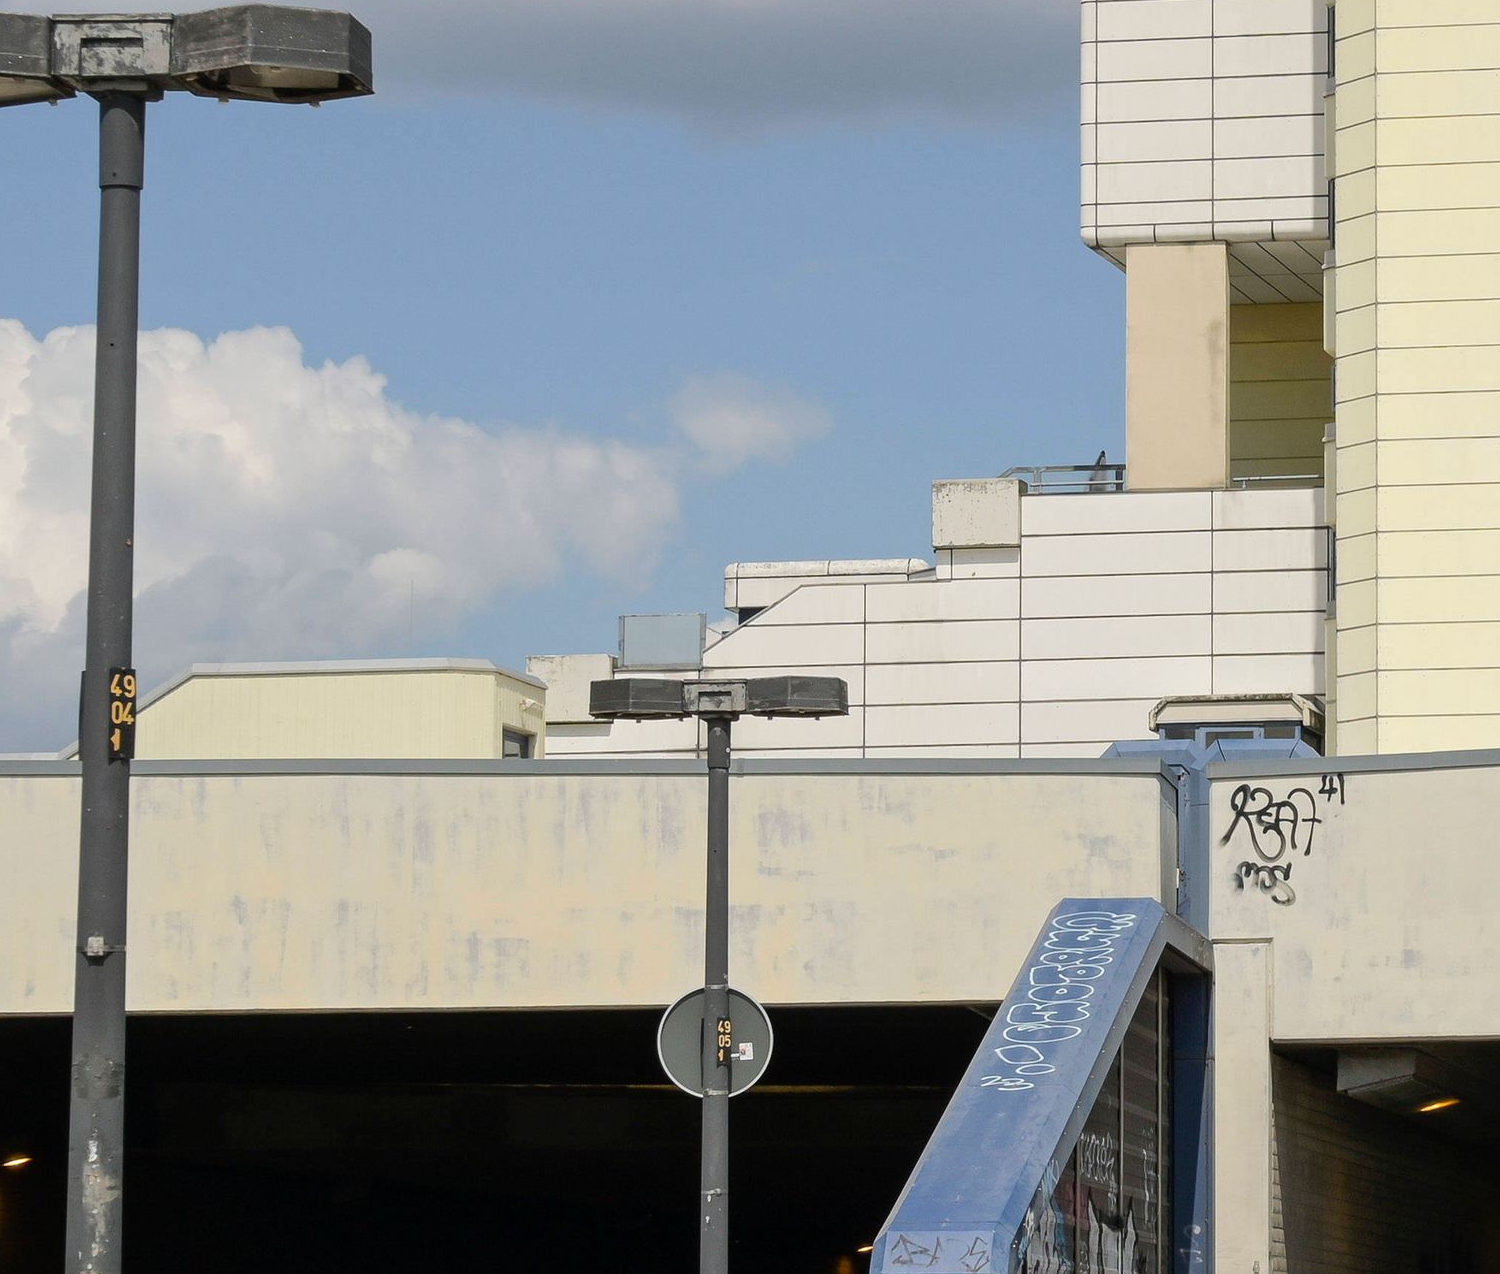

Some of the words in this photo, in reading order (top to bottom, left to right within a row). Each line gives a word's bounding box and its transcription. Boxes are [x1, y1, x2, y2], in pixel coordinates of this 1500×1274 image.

[110, 673, 136, 698] 49
[111, 700, 135, 725] 04
[717, 1020, 731, 1033] 49
[718, 1034, 731, 1047] 05
